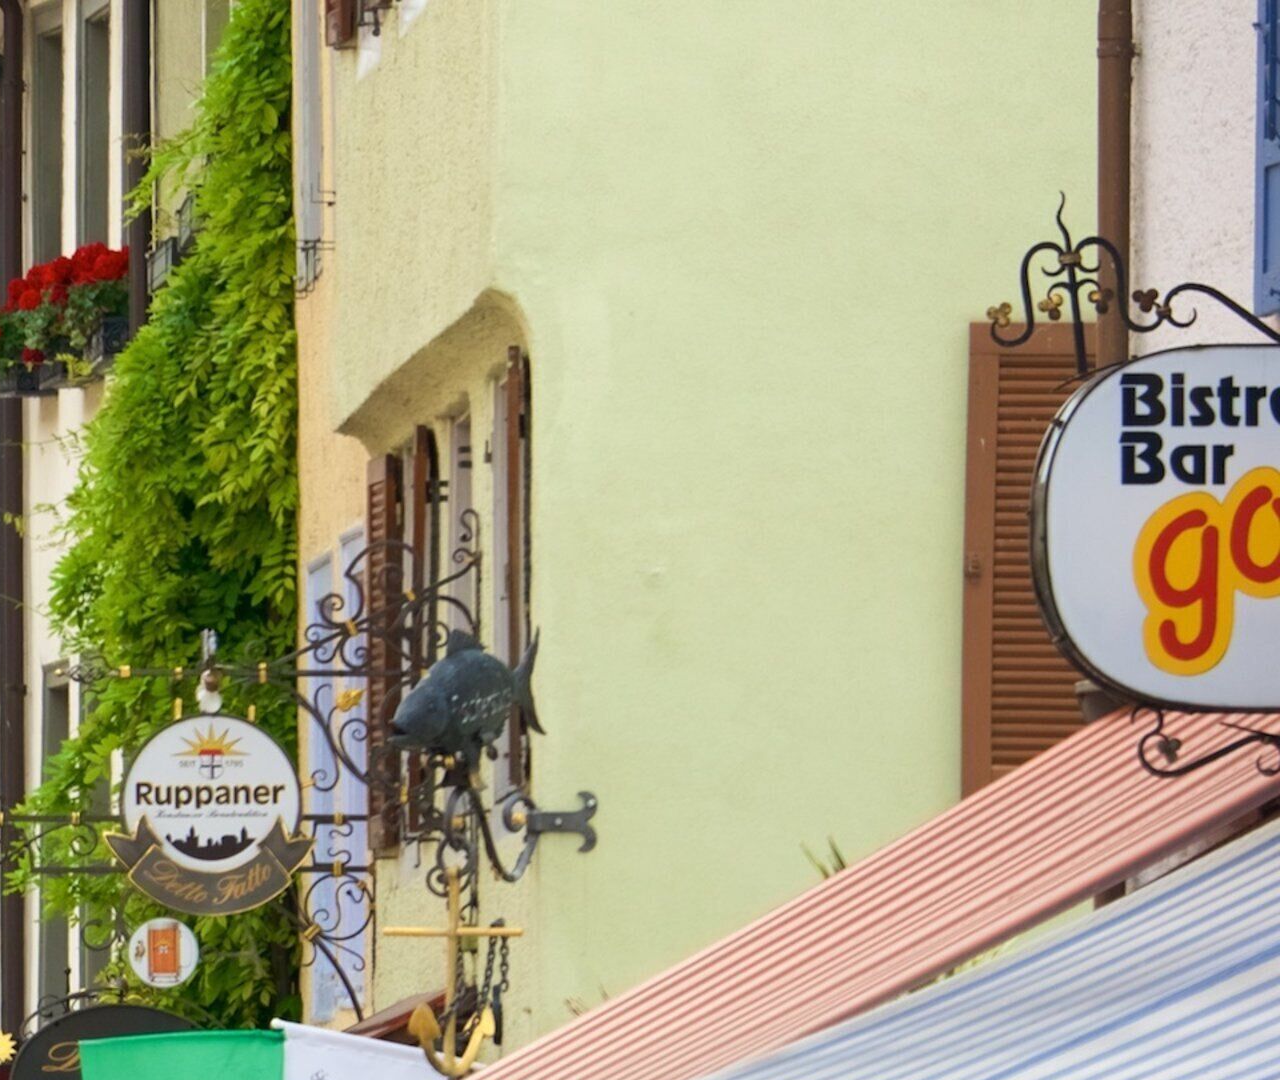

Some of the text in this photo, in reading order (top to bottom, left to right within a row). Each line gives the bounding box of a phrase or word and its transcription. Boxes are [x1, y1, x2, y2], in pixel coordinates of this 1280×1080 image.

[1120, 373, 1280, 427] Bistr
[1119, 431, 1234, 485] Bar
[136, 782, 285, 809] Ruppaner
